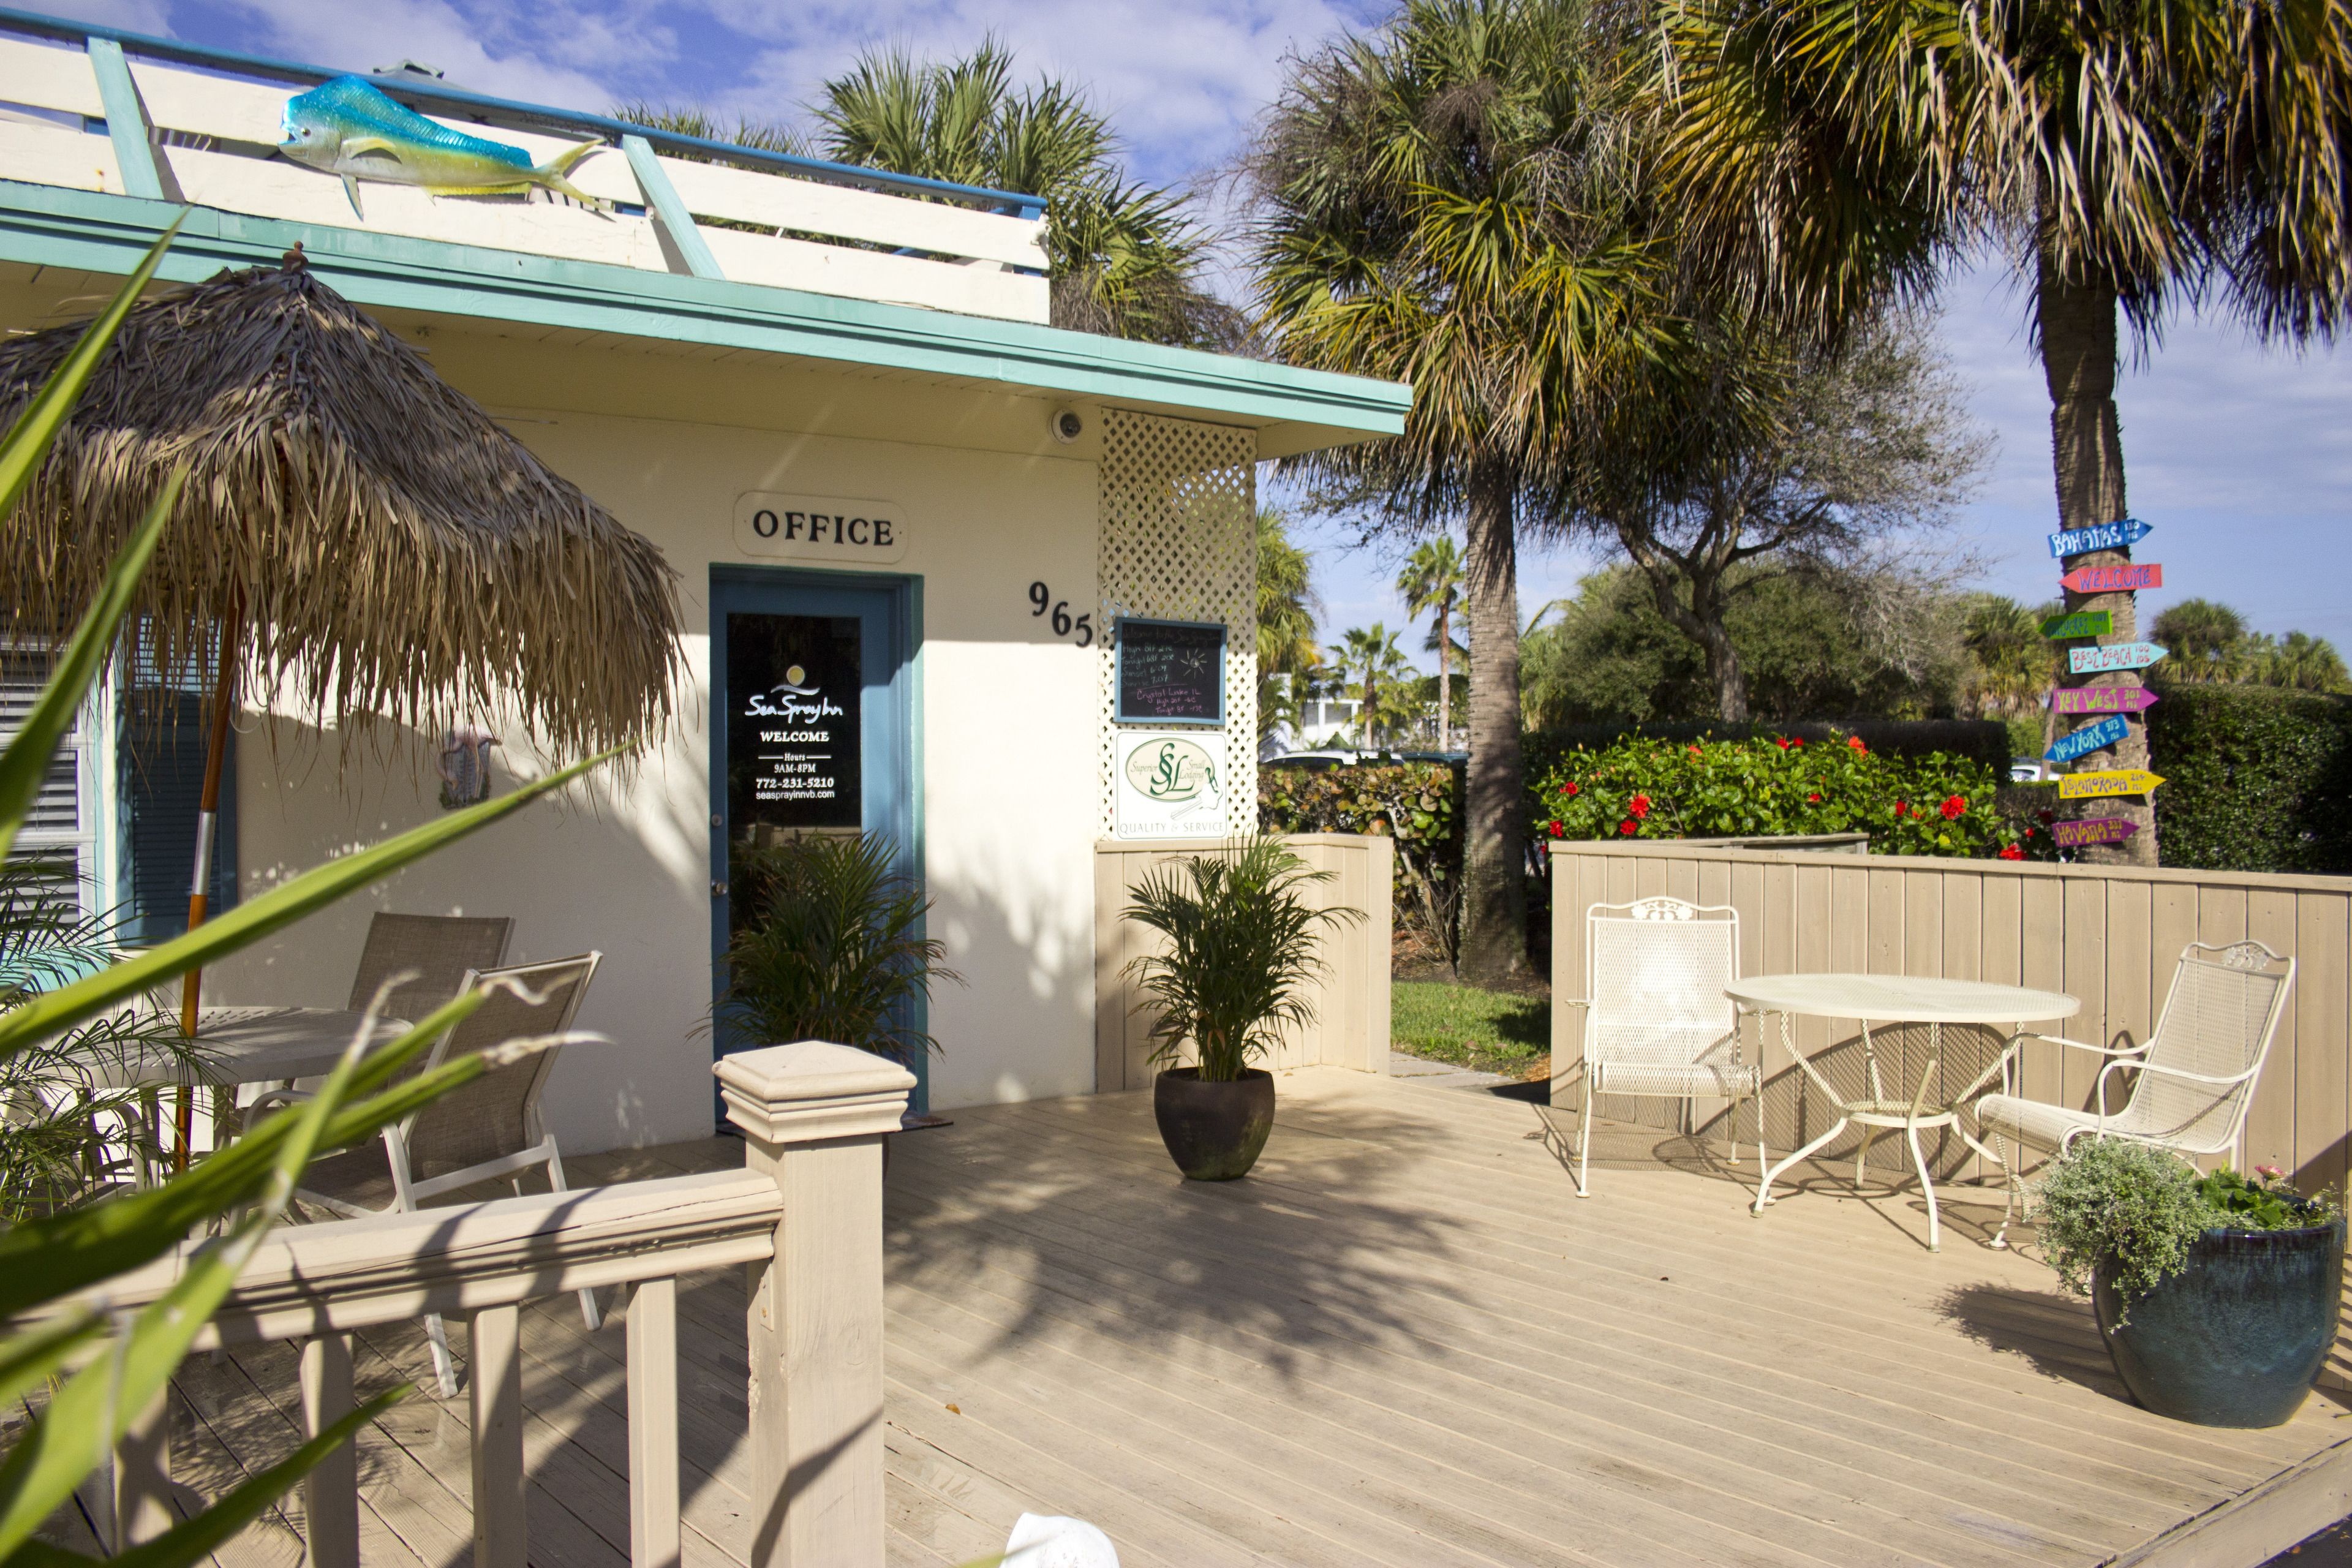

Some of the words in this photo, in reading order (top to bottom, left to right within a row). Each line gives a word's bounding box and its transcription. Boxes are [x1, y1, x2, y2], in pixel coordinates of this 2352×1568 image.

[753, 510, 894, 546] OFFICE
[2051, 526, 2122, 557] BAHAMAS
[2077, 567, 2152, 590] WELCOME
[1029, 581, 1093, 648] 965
[2071, 649, 2099, 671] BEST
[2101, 647, 2132, 668] BEACH
[1137, 688, 1166, 703] Crystal
[2057, 692, 2080, 711] KEY
[745, 695, 777, 716] Sea
[777, 695, 821, 724] Spray
[821, 696, 843, 716] Inn
[760, 731, 830, 742] WELCOME
[2076, 724, 2106, 752] YORK
[784, 753, 806, 761] Hours
[1186, 759, 1206, 771] Small
[1130, 761, 1158, 775] Superior
[1178, 770, 1205, 782] Lodging
[756, 777, 835, 788] 772-231-5210
[756, 790, 835, 801] seasprayinnvb.com
[1120, 823, 1167, 834] QUALITY
[1183, 822, 1224, 832] SERVICE
[2056, 823, 2107, 844] HAVANA
